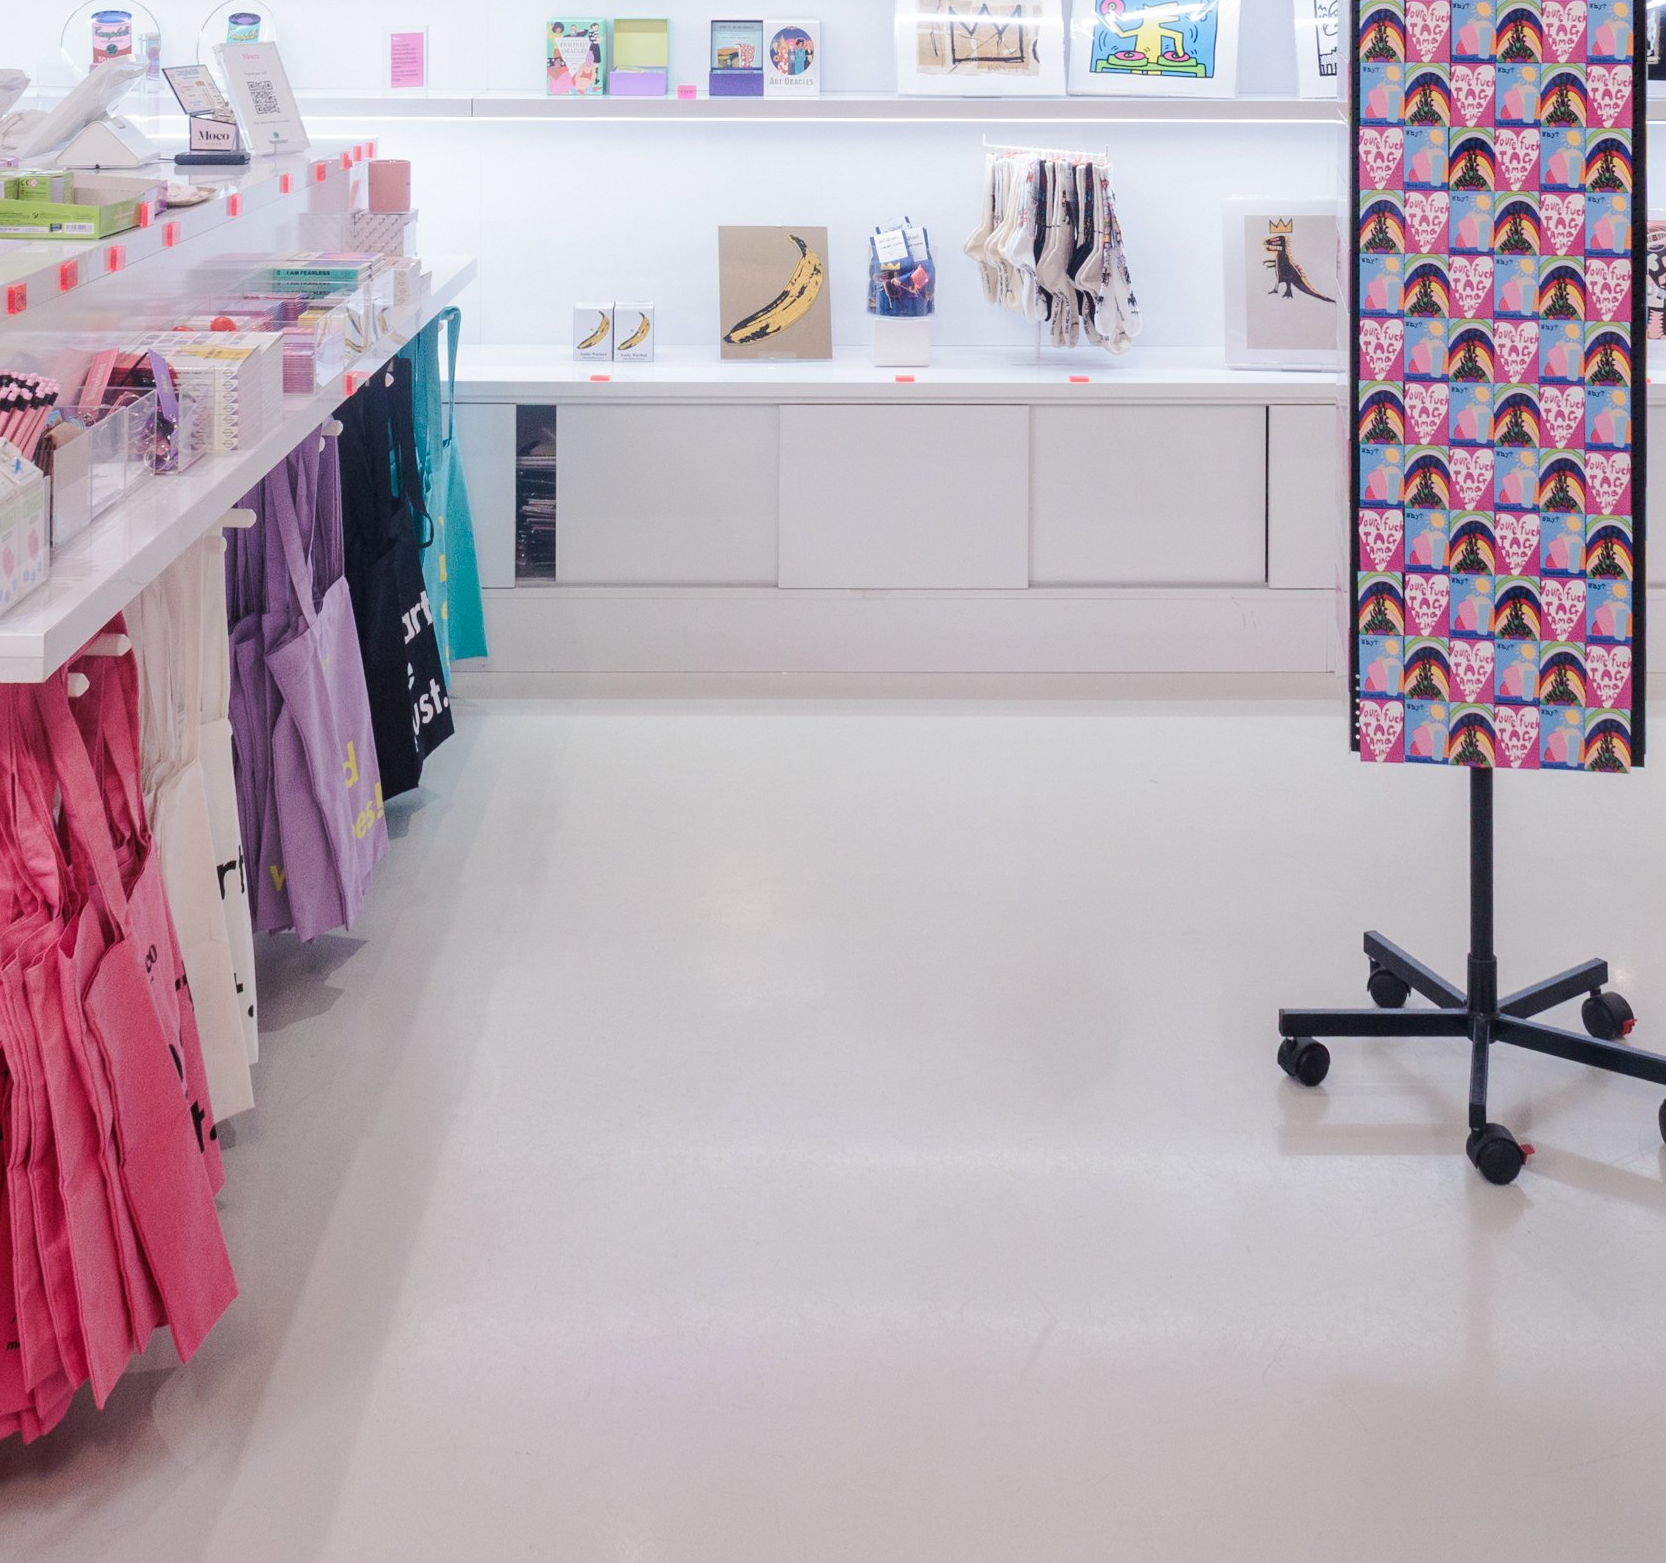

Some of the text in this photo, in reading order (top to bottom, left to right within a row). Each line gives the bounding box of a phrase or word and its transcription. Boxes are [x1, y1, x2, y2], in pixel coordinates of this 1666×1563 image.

[768, 77, 814, 86] ART ORACLES
[198, 129, 230, 142] Moco
